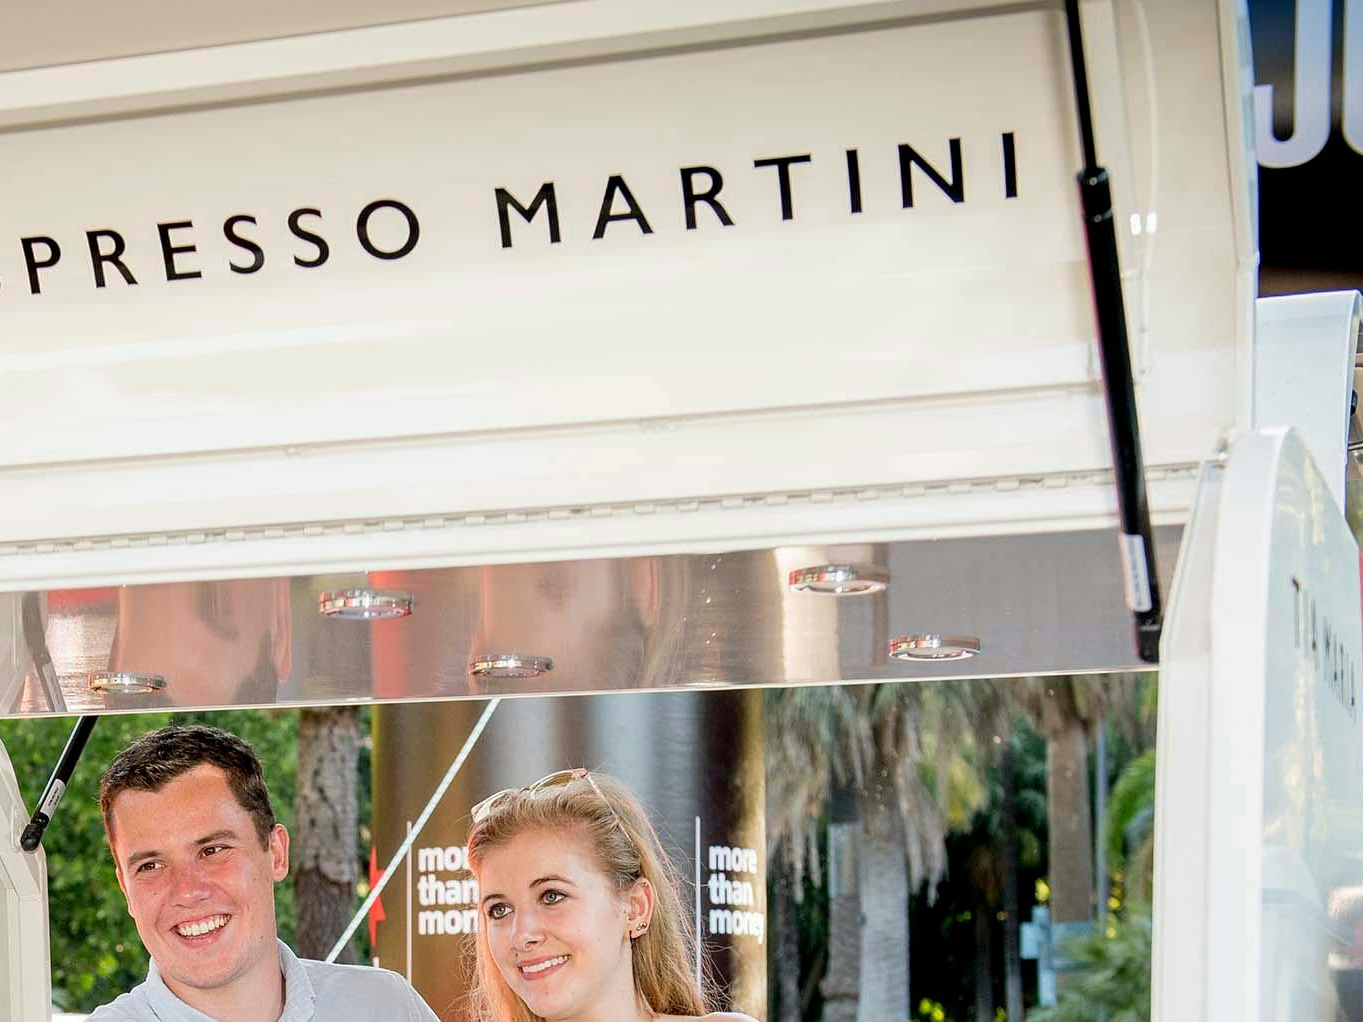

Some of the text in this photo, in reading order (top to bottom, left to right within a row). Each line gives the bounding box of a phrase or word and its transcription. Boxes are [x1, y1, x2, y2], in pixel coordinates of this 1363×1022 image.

[494, 131, 1018, 248] MARTINI
[709, 846, 758, 874] more
[418, 873, 479, 905] than
[708, 872, 754, 906] than
[418, 909, 479, 935] mon
[709, 908, 765, 945] money
